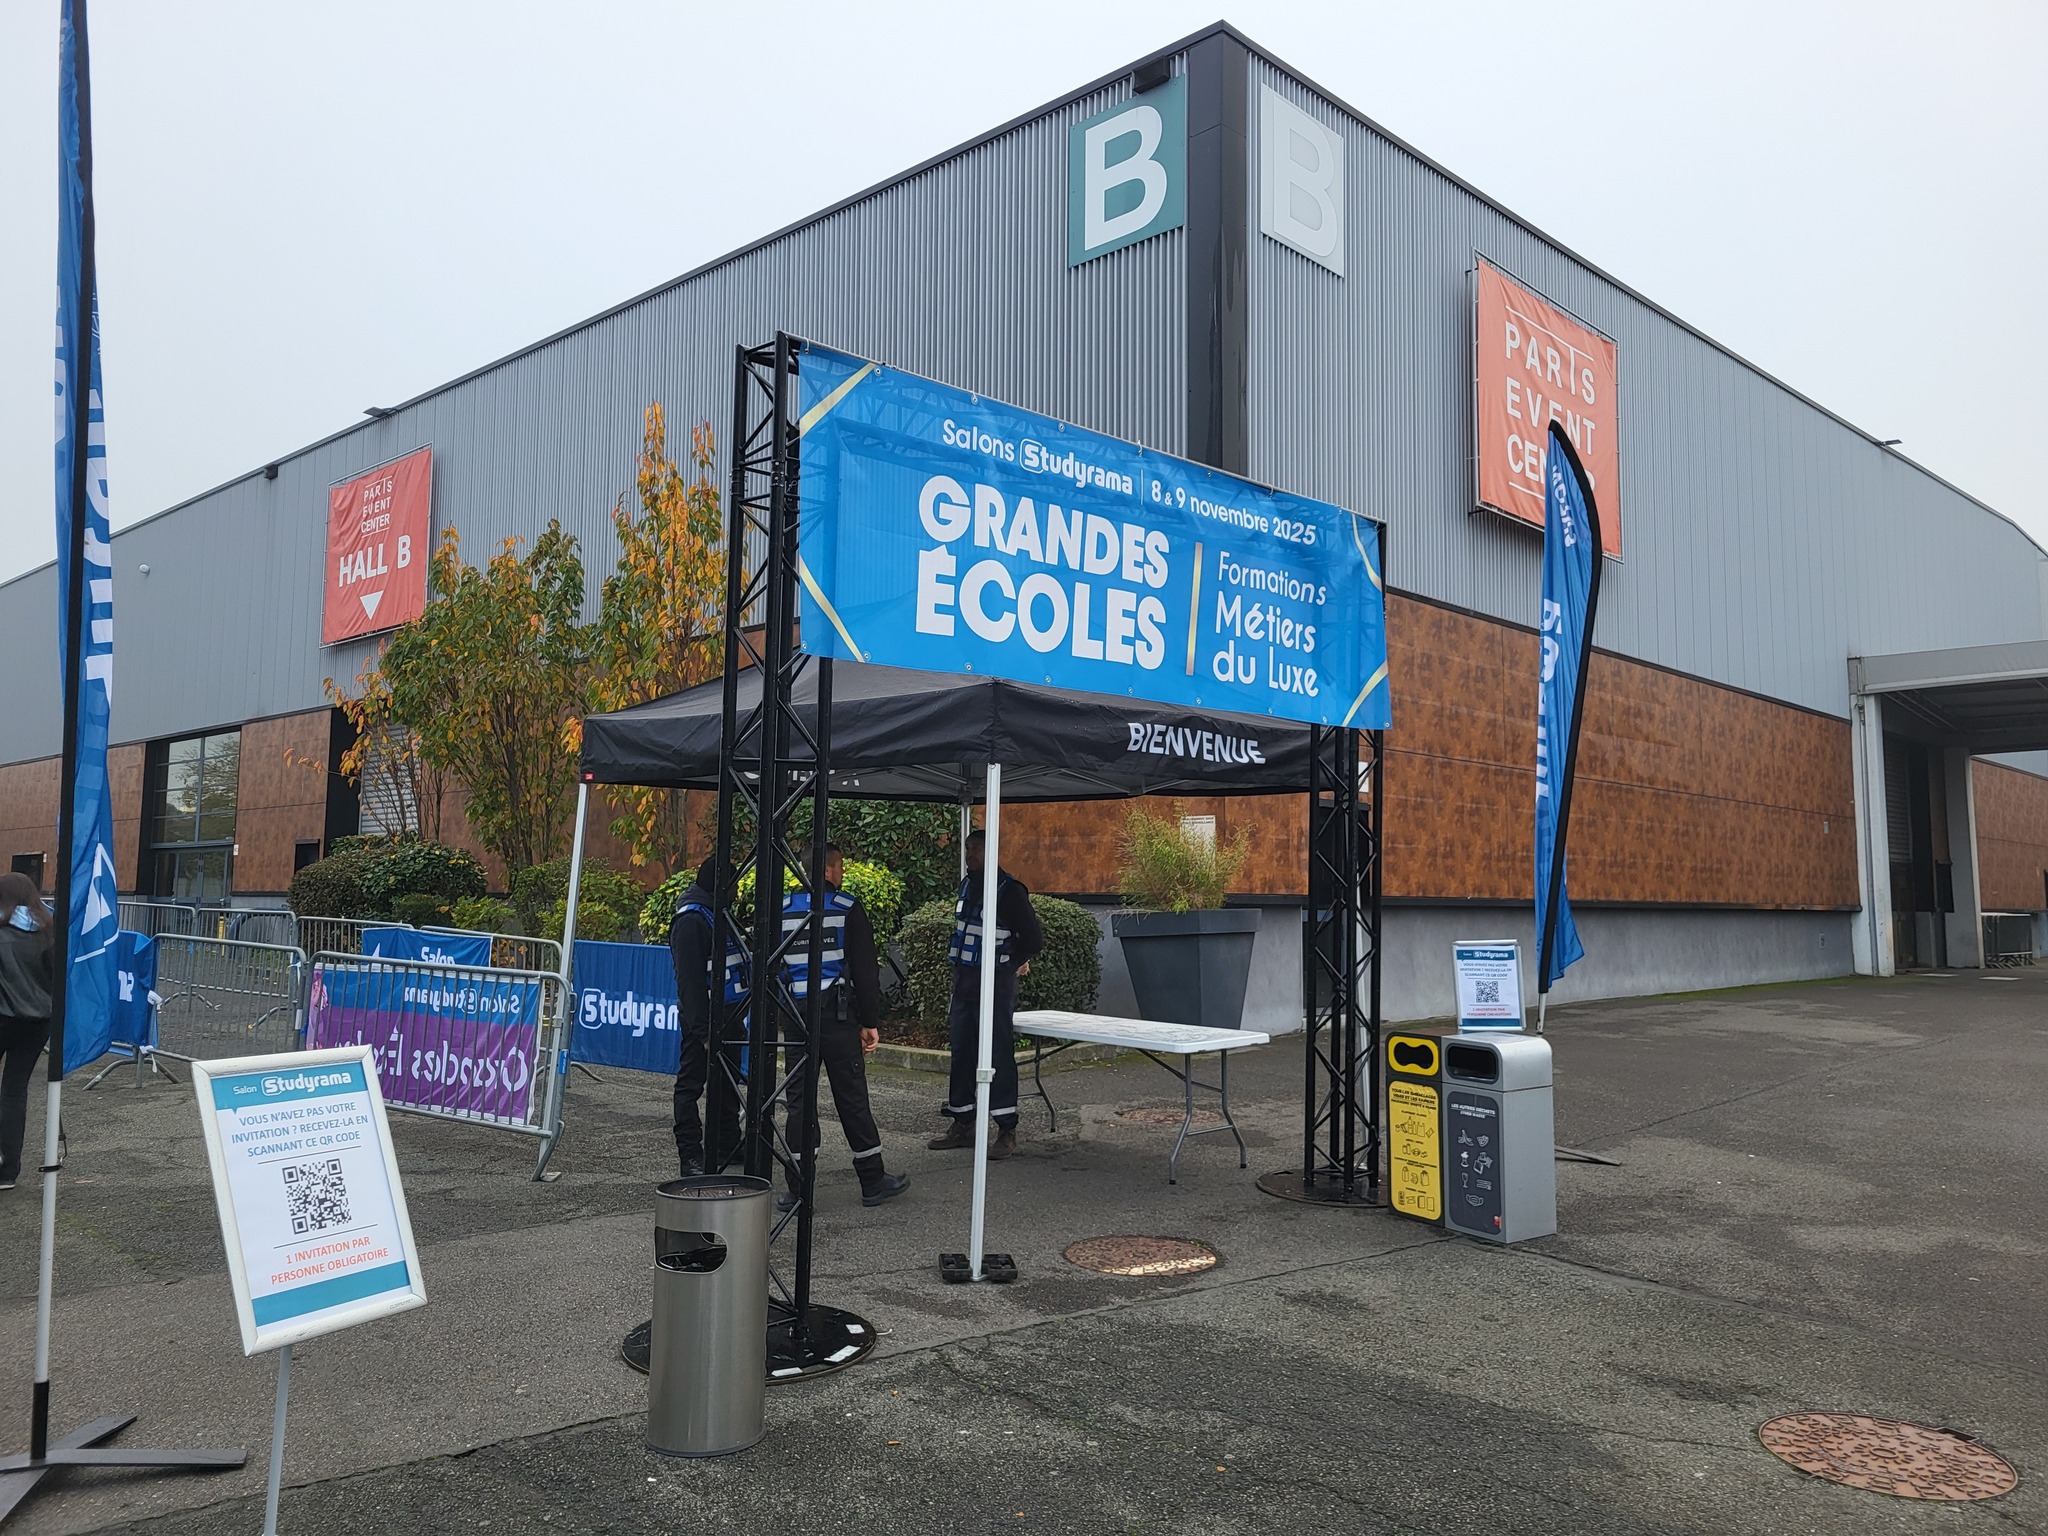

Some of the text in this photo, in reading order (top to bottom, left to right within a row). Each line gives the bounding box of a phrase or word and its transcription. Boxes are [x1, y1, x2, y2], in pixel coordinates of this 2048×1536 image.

[1085, 105, 1167, 251] B
[1273, 96, 1338, 258] B
[1505, 320, 1595, 405] PARIS
[363, 478, 393, 502] PARIS
[943, 418, 1317, 546] Salons Studyrama 8 & 9 novembre 2025
[360, 513, 390, 533] CENTER
[362, 496, 392, 518] EVENT
[918, 474, 1170, 589] GRANDES
[339, 534, 411, 588] HALL B
[1218, 550, 1327, 606] Formations
[915, 544, 1167, 670] ÉCOLES
[1215, 594, 1316, 654] Métiers
[1212, 640, 1320, 698] du Luxe
[1126, 722, 1266, 764] BIENVENUE
[583, 990, 681, 1037] Studyram
[232, 1072, 352, 1095] Salon Studyrama
[231, 1115, 369, 1144] INVITATION ? RECEVEZ-LA EN
[239, 1114, 269, 1126] VOUS
[306, 1106, 324, 1117] PAS
[326, 1102, 356, 1114] VOTRE
[247, 1130, 361, 1157] SCANNANT CE QR CODE
[271, 1247, 389, 1285] PERSONNE OBLIGATOIRE
[286, 1236, 371, 1265] 1 INVITATION PAR
